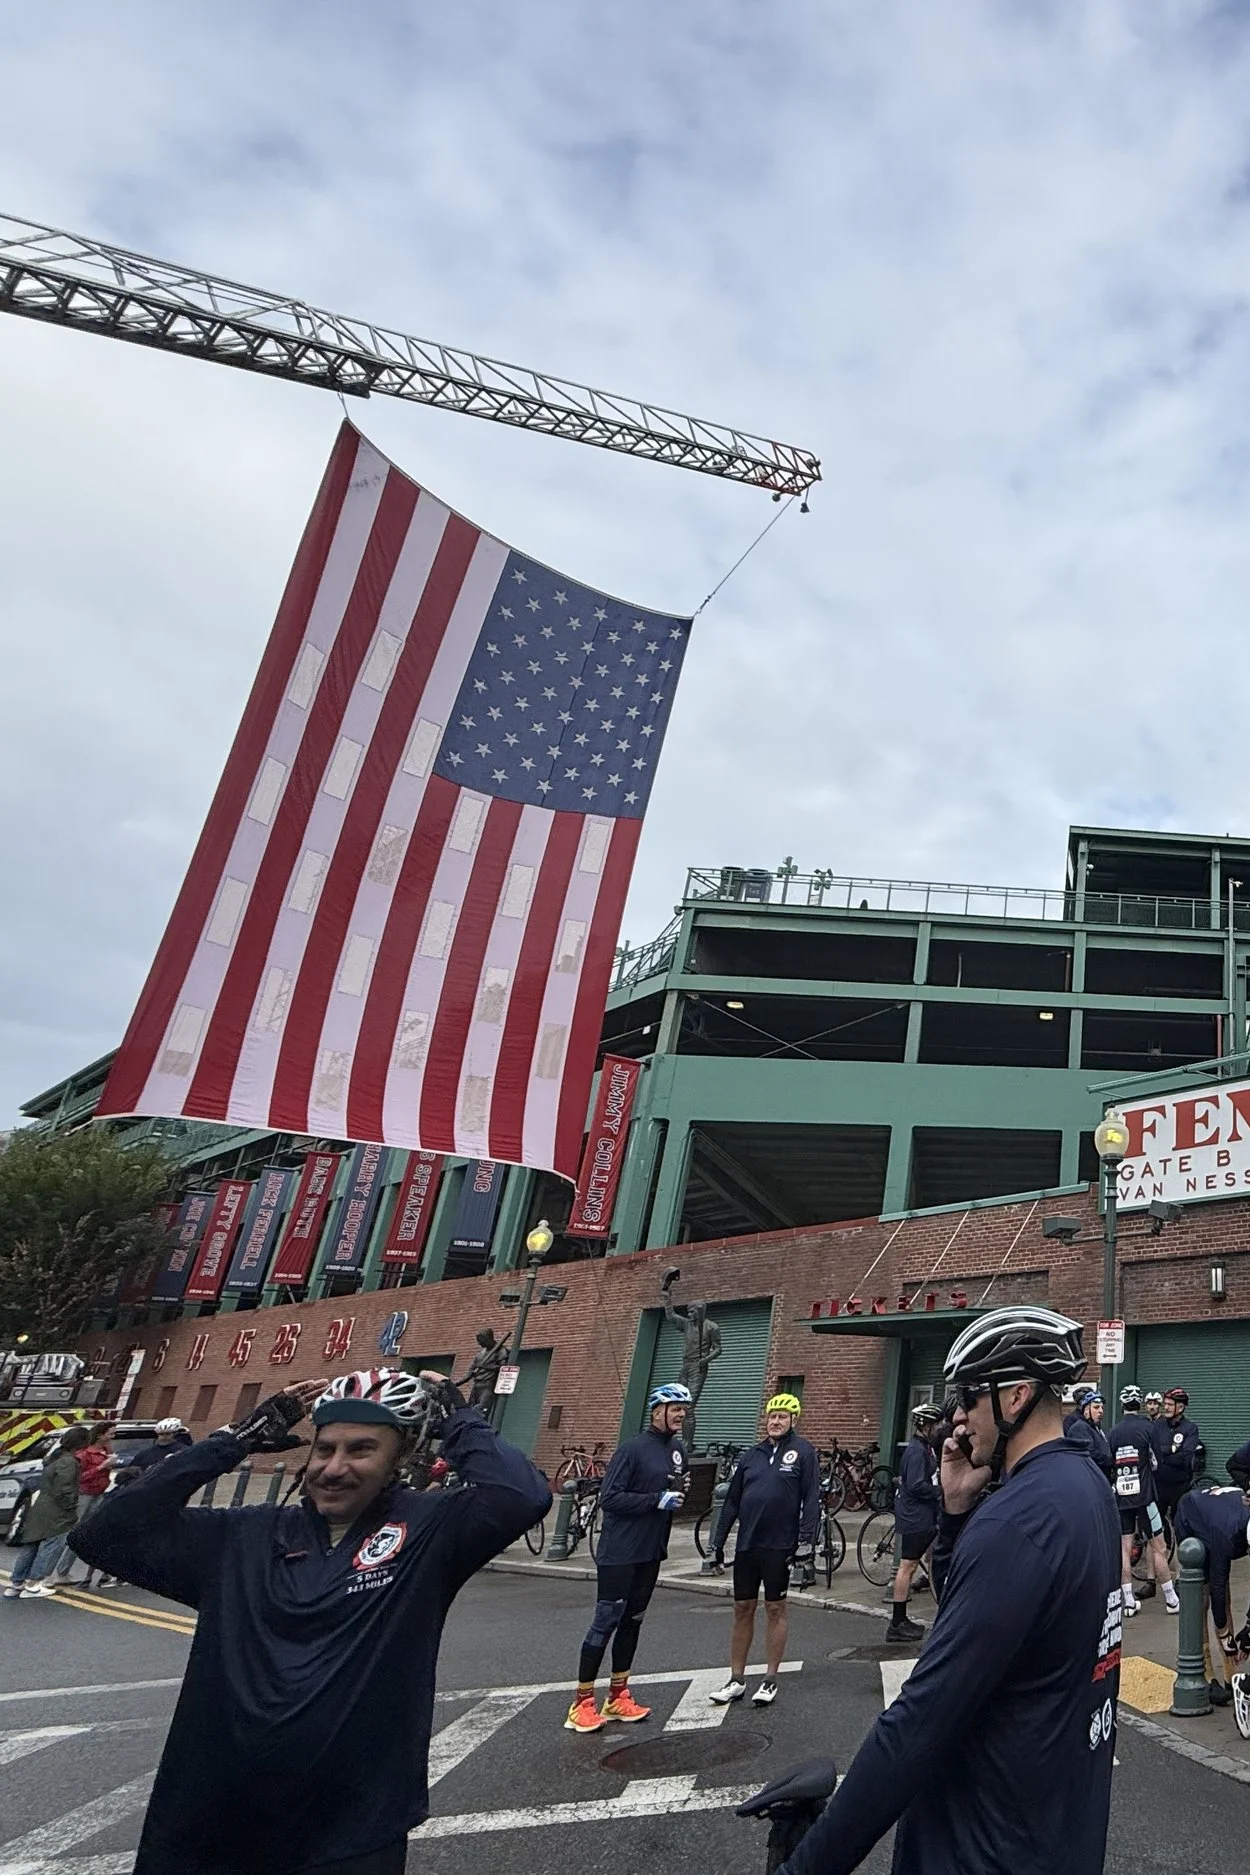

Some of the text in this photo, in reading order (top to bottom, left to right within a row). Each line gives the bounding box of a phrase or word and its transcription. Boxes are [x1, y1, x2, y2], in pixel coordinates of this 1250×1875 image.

[582, 1063, 630, 1222] JIMMY COLLINS
[1120, 1155, 1192, 1181] GATE
[1217, 1149, 1231, 1167] B
[335, 1143, 382, 1261] HARRY HOOPER
[397, 1164, 433, 1241] SPEAKER
[1119, 1182, 1163, 1201] VAN
[200, 1184, 244, 1277] LEFTY GROVE
[808, 1292, 968, 1318] TICKETS
[228, 1328, 257, 1368] 45
[321, 1317, 357, 1361] 34
[381, 1311, 408, 1356] 42
[1122, 1483, 1134, 1491] 187
